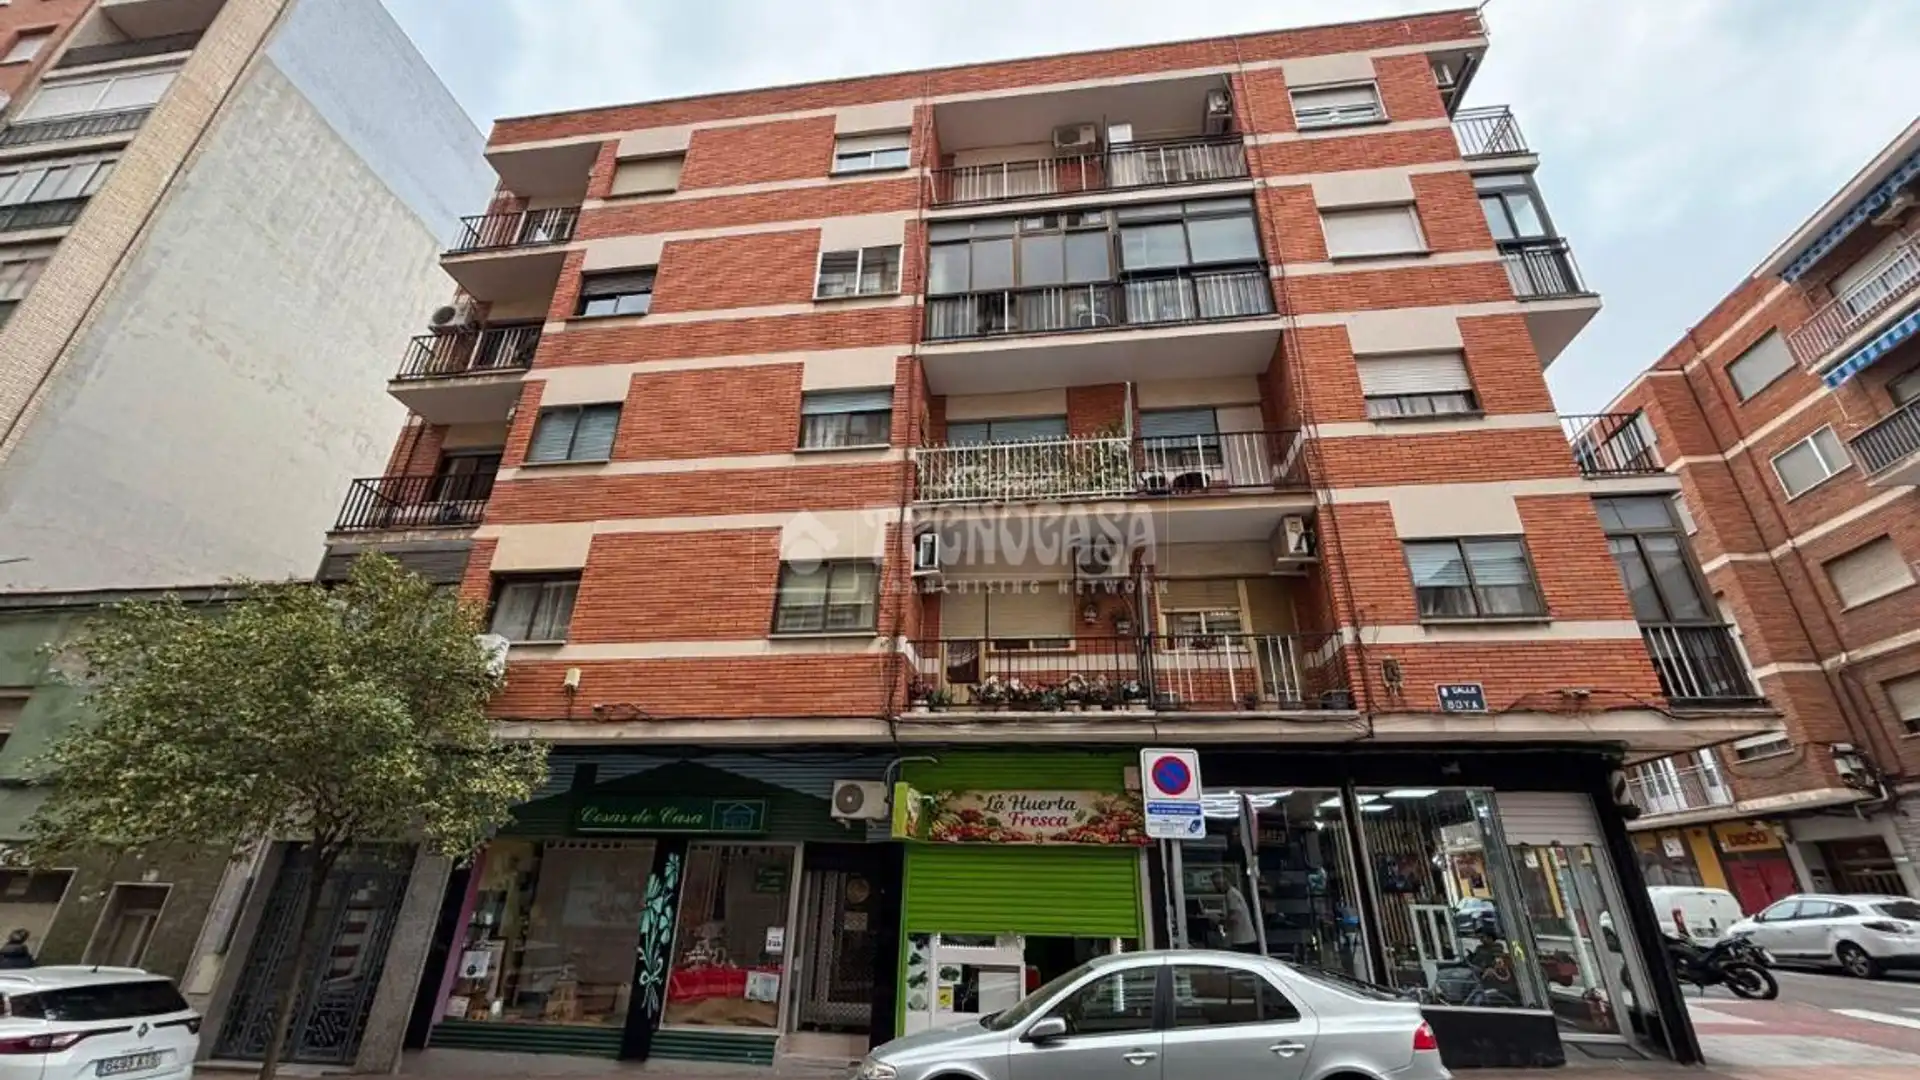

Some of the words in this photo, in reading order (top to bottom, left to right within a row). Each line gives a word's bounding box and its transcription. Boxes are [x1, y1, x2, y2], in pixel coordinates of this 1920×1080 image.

[1451, 686, 1477, 694] CALLE
[1447, 699, 1480, 709] BOYA
[1008, 794, 1076, 810] Huerta
[580, 805, 627, 824] Cosas
[631, 807, 652, 823] de
[659, 805, 704, 824] Casa
[1008, 811, 1069, 827] Fresca
